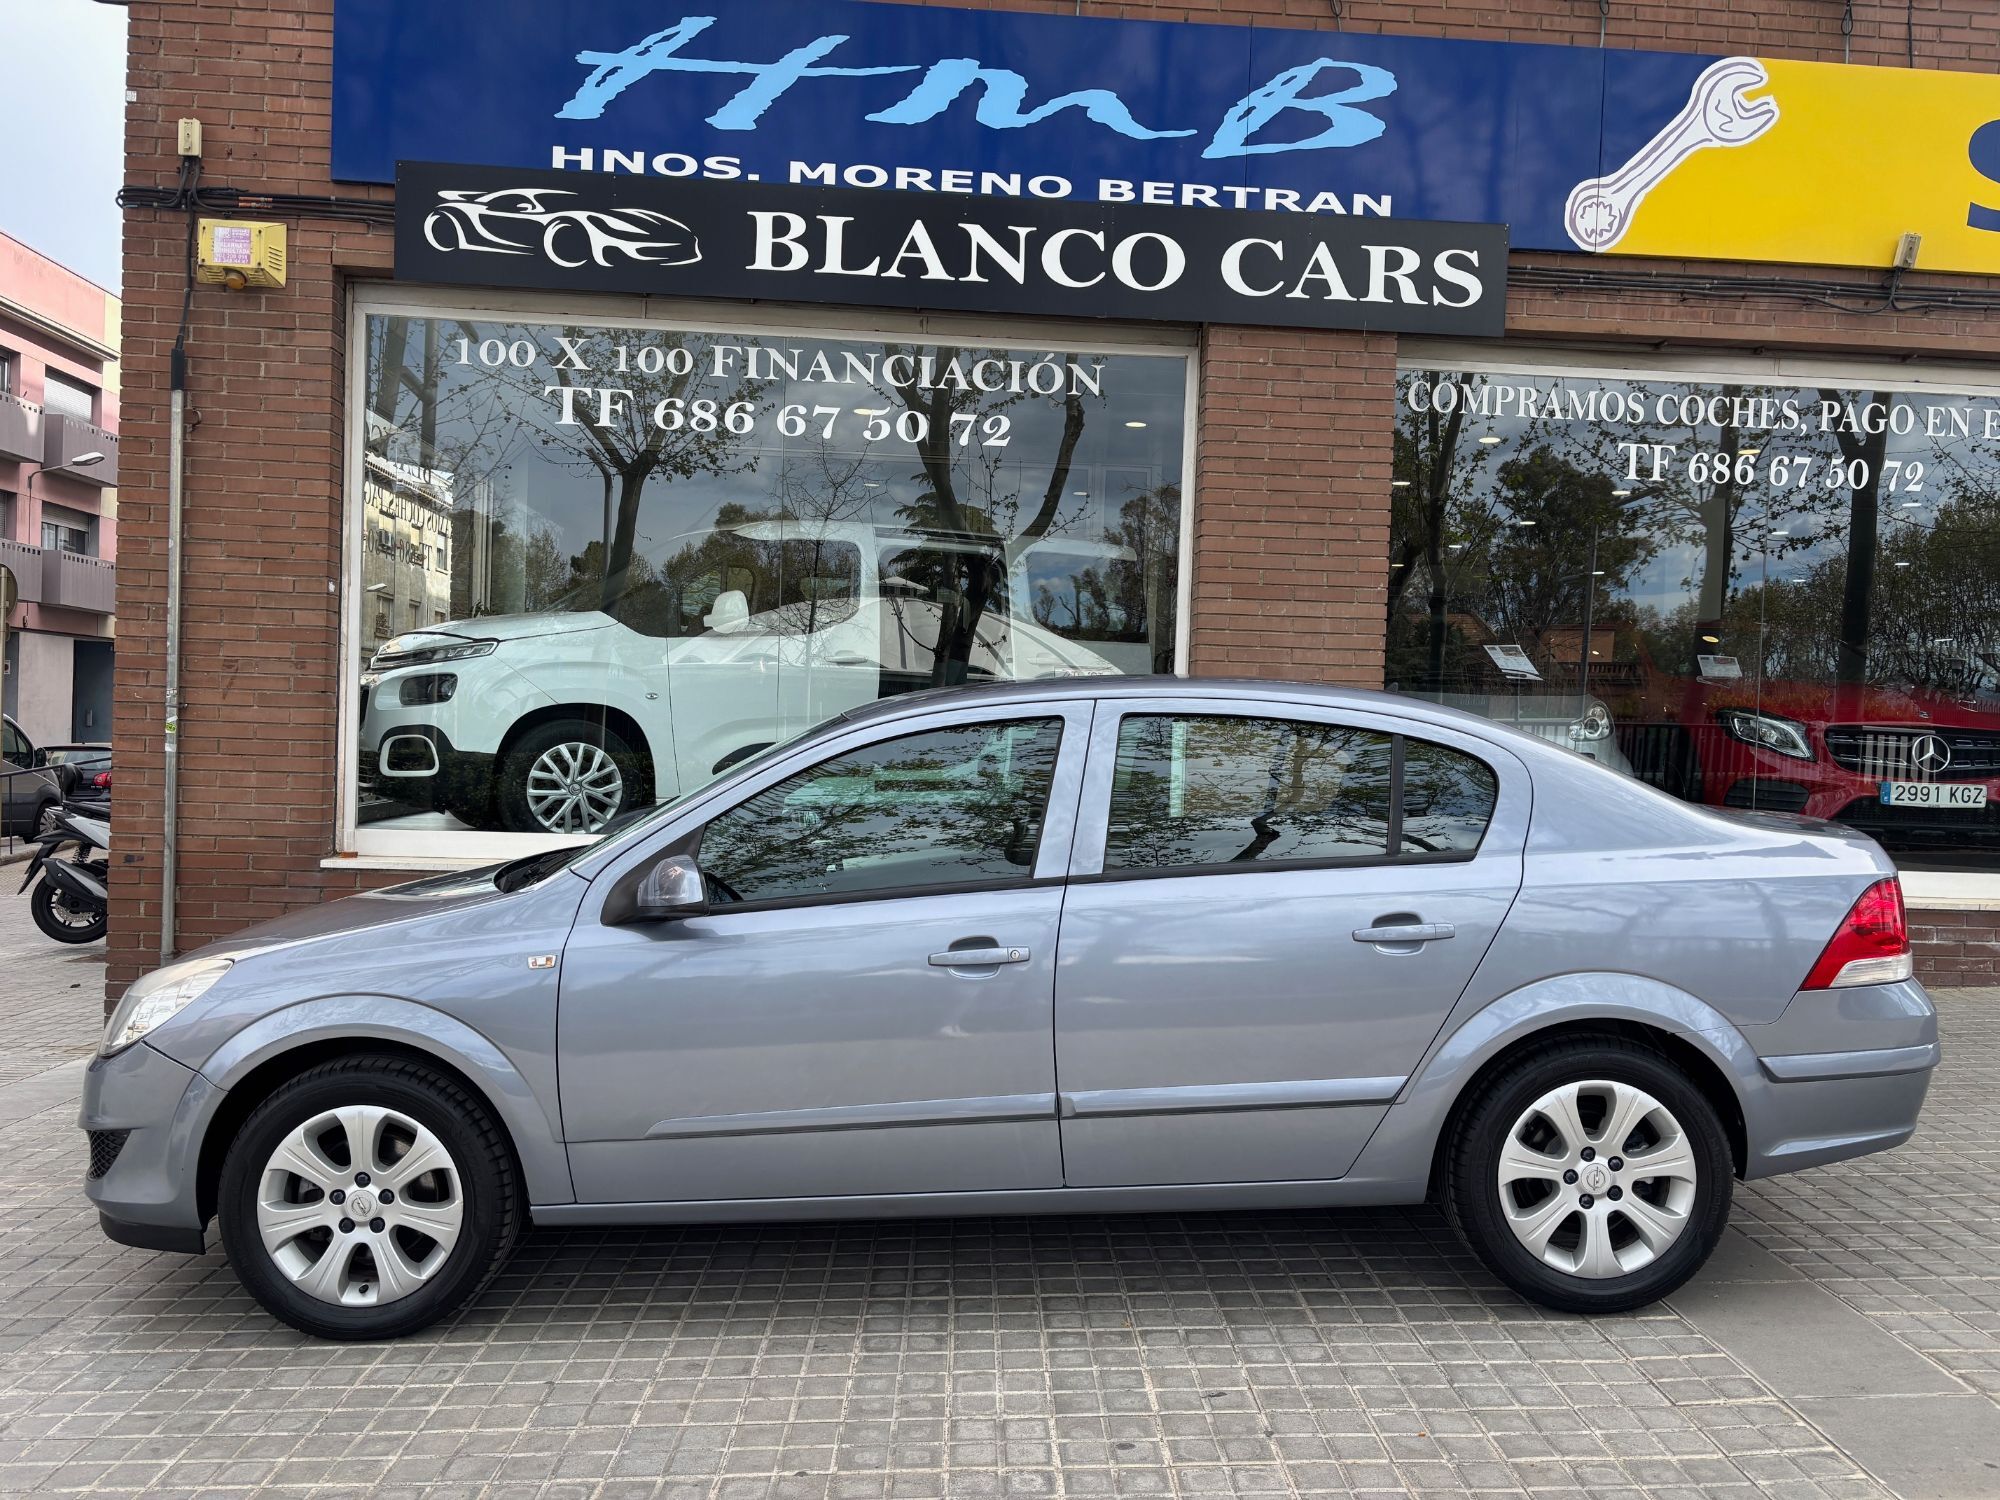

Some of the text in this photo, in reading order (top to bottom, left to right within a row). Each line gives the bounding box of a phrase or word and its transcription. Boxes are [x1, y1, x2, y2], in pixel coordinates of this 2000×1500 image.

[552, 145, 1392, 217] HNOS. MORENO BERTRAN
[745, 210, 1483, 308] BLANCO CARS
[454, 336, 1105, 397] 100 X 100 FINANCIACIÓN
[544, 385, 1011, 447] TF 686 67 50 72
[1408, 380, 1645, 424] COMPRAMOS
[1655, 393, 1808, 437] COCHES,
[1818, 400, 1915, 435] PAGO
[1924, 405, 1976, 438] EN
[1617, 442, 1924, 492] TF 686 67 50 72
[1894, 784, 1984, 804] 2991 KGZ
